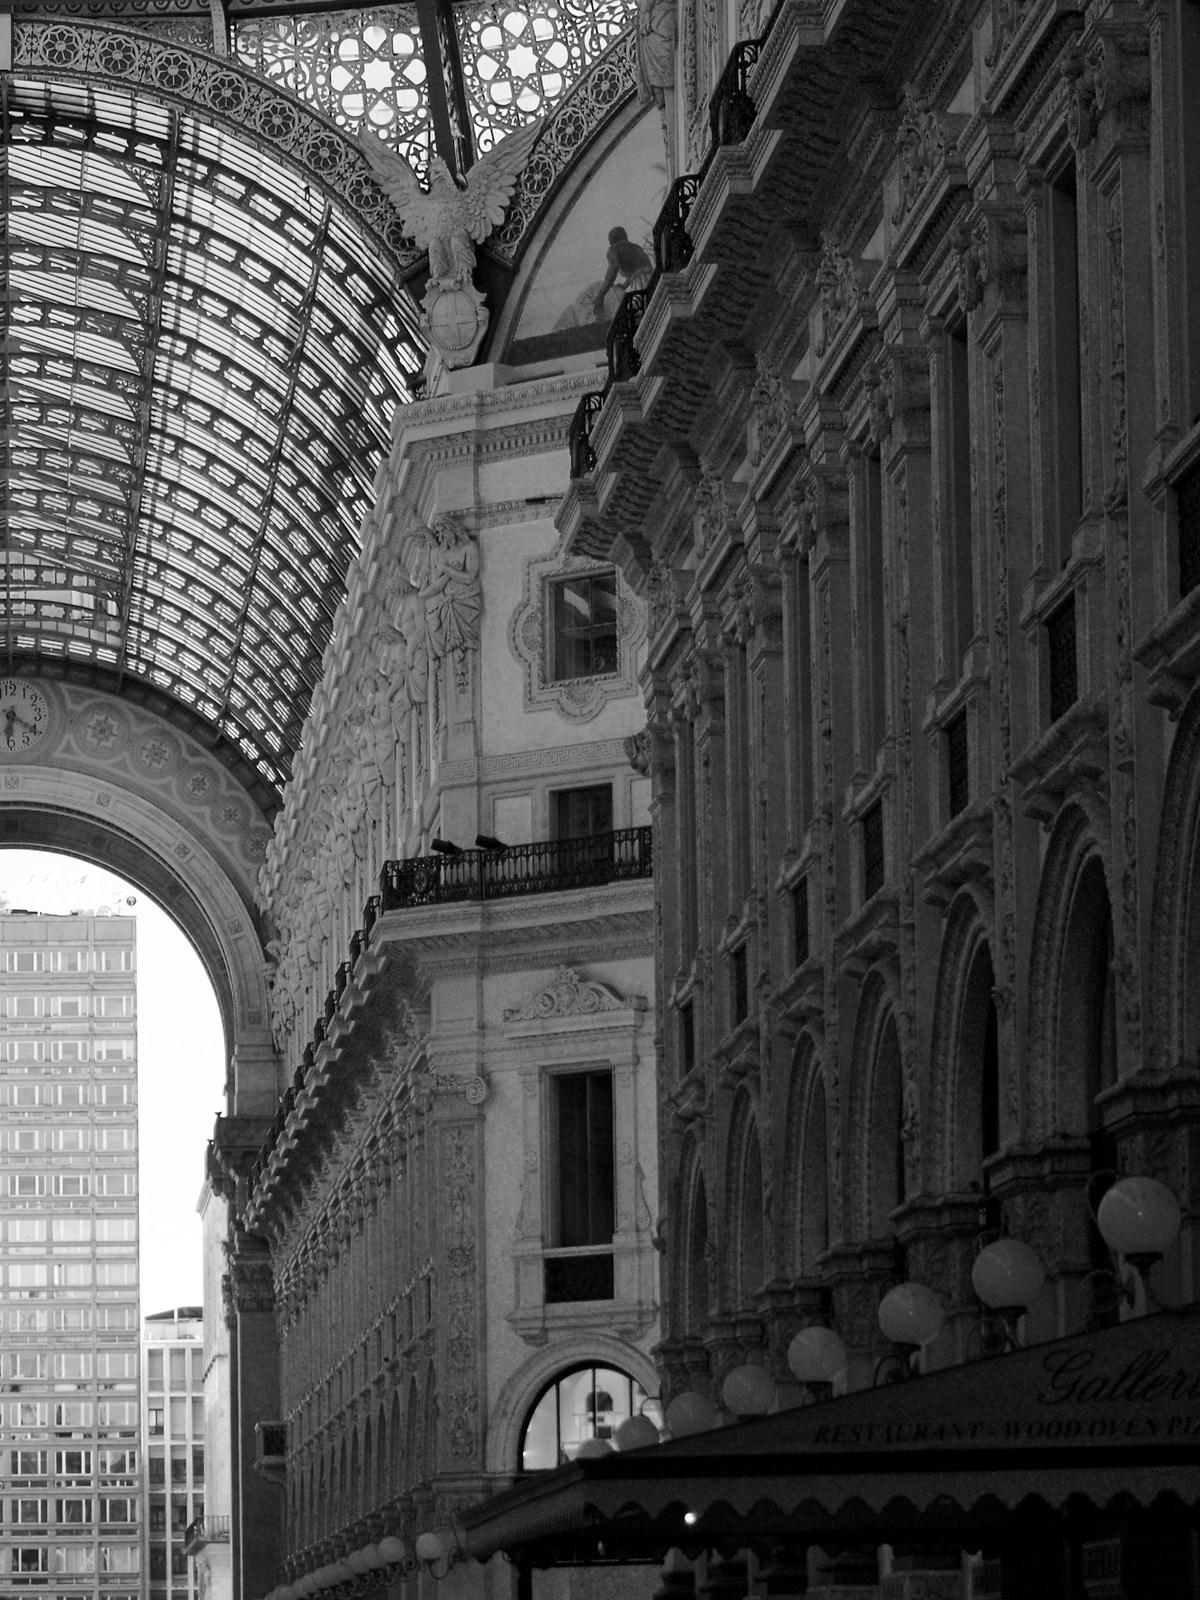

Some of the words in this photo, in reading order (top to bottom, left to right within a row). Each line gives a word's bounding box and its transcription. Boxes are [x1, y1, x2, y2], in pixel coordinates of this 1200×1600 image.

[4, 683, 17, 696] 12
[30, 694, 38, 707] 2
[34, 707, 42, 721] 3
[29, 723, 37, 736] 4
[6, 735, 16, 749] 6
[22, 732, 30, 745] 5
[814, 1421, 983, 1445] RESTAURANT
[1005, 1418, 1082, 1439] WOOD
[1089, 1417, 1166, 1438] OVEN
